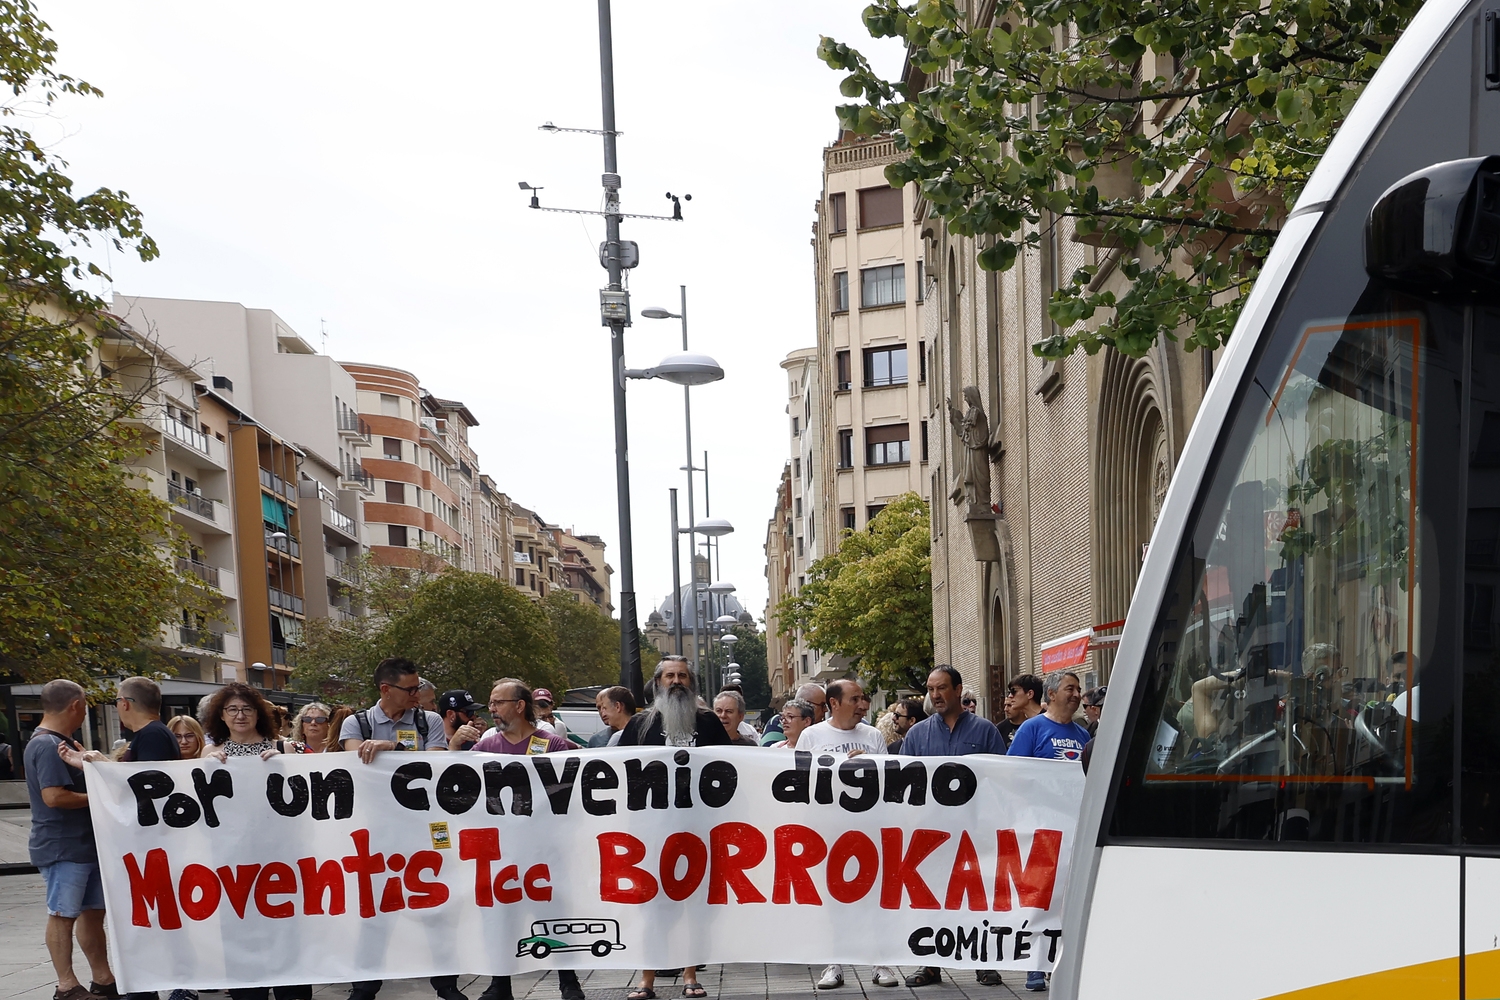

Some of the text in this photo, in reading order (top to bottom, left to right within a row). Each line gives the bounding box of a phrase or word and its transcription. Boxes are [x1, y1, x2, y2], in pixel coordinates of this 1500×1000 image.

[126, 749, 978, 829] Por un convenio digno
[122, 827, 451, 931] Moventis
[596, 821, 1064, 913] BORROKAN
